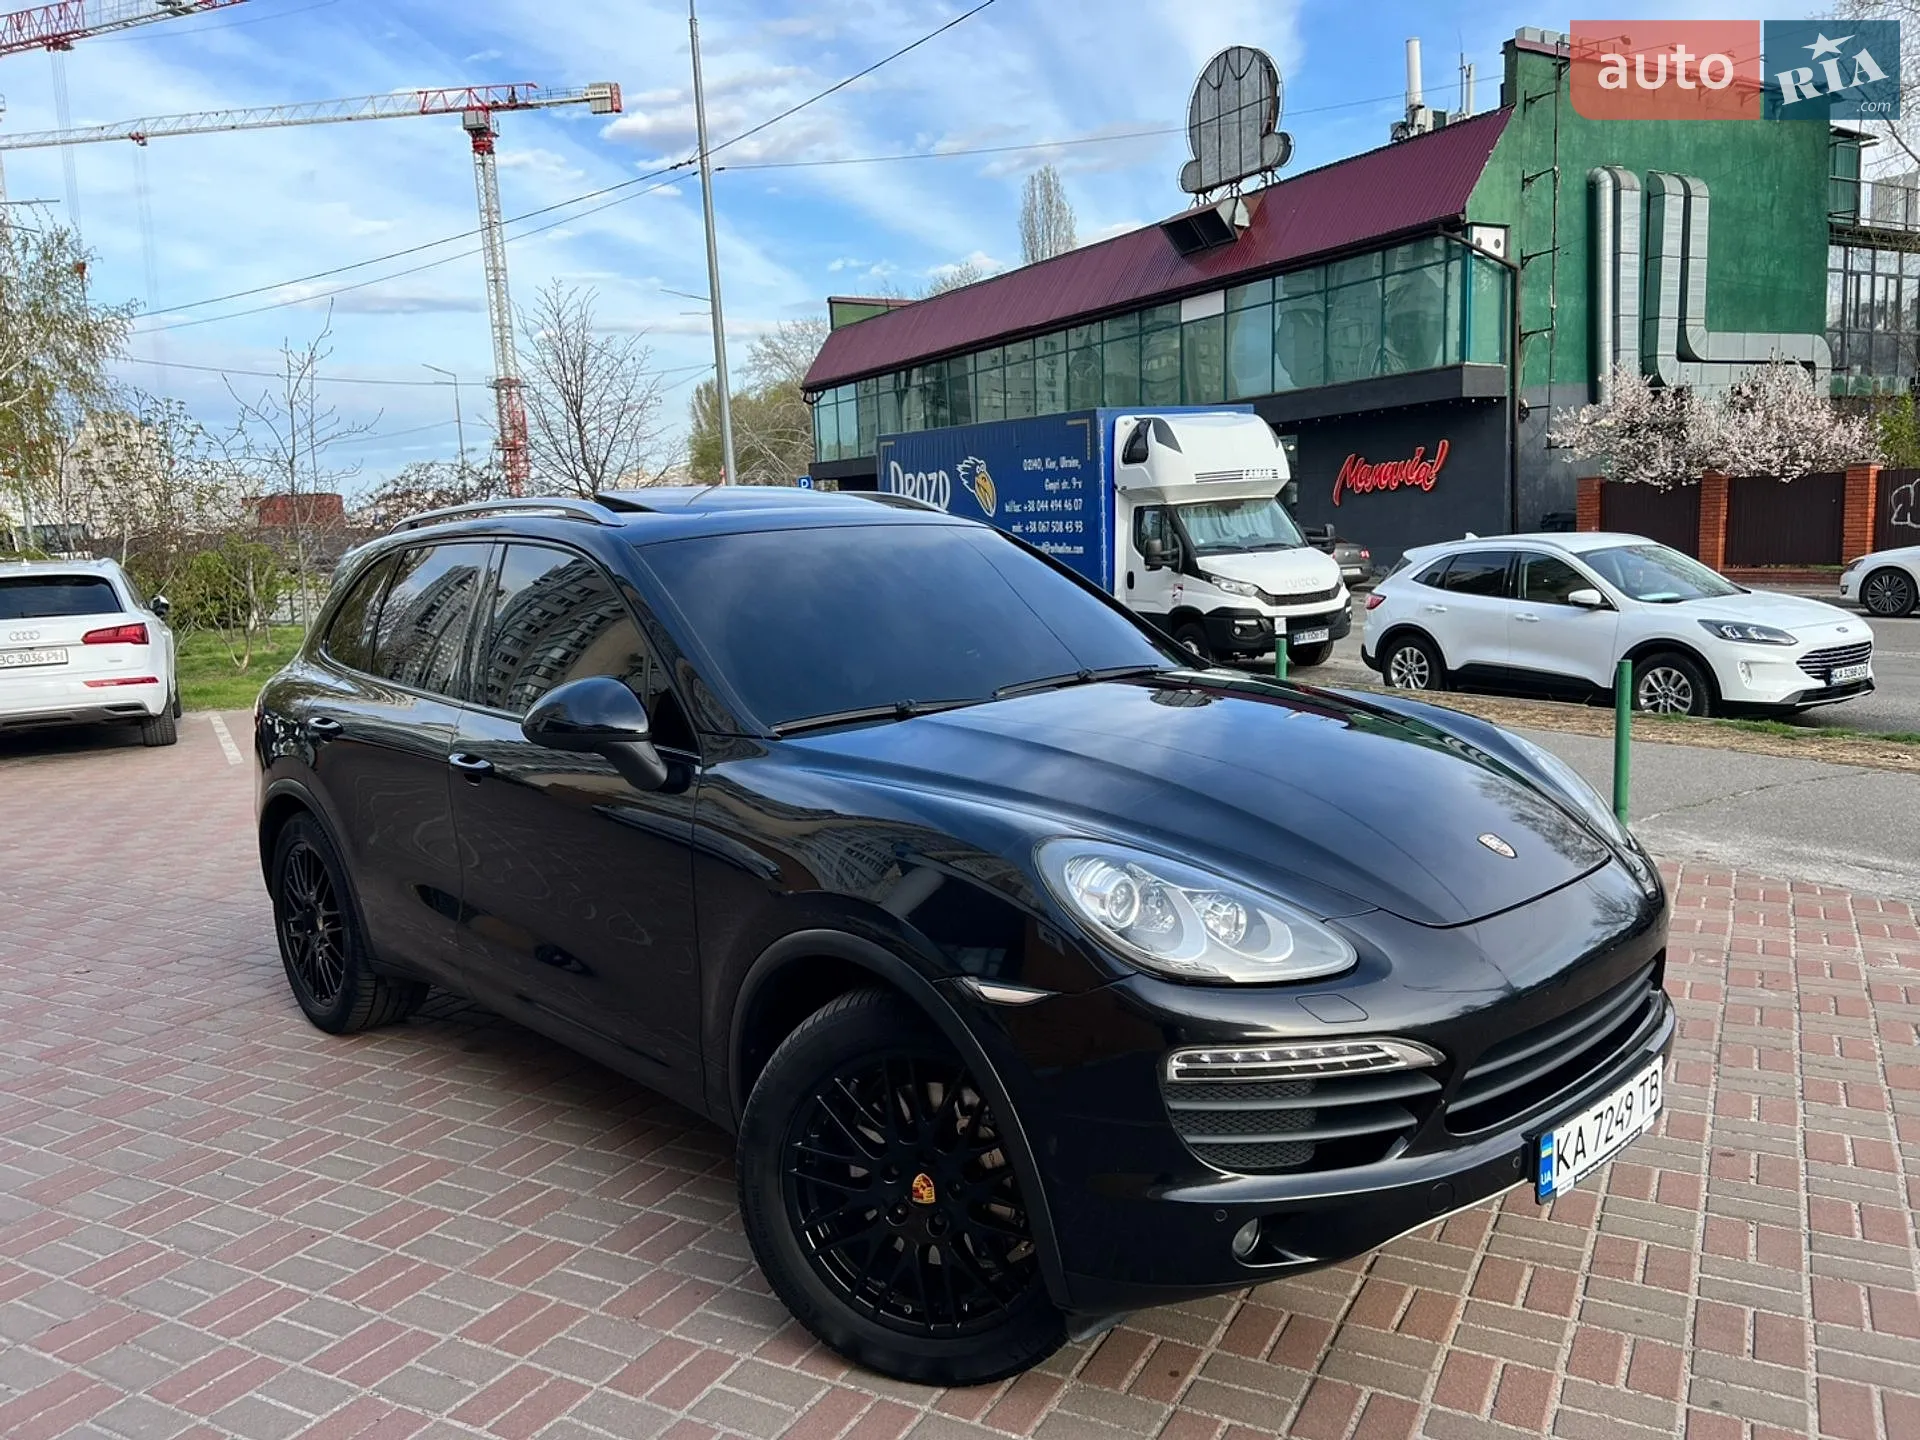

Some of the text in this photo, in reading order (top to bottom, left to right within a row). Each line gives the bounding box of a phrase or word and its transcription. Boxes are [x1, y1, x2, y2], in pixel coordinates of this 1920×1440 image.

[1023, 500, 1035, 512] +38
[1037, 499, 1048, 512] 044
[1050, 499, 1062, 511] 494
[1074, 498, 1083, 510] 07
[1025, 521, 1037, 533] +38
[1038, 521, 1050, 533] 067
[1285, 576, 1320, 589] IVECO
[17, 651, 44, 664] 3036
[1556, 1125, 1587, 1177] KA
[1593, 1091, 1634, 1152] 7249
[1638, 1069, 1659, 1116] TB
[1540, 1170, 1552, 1186] UA
